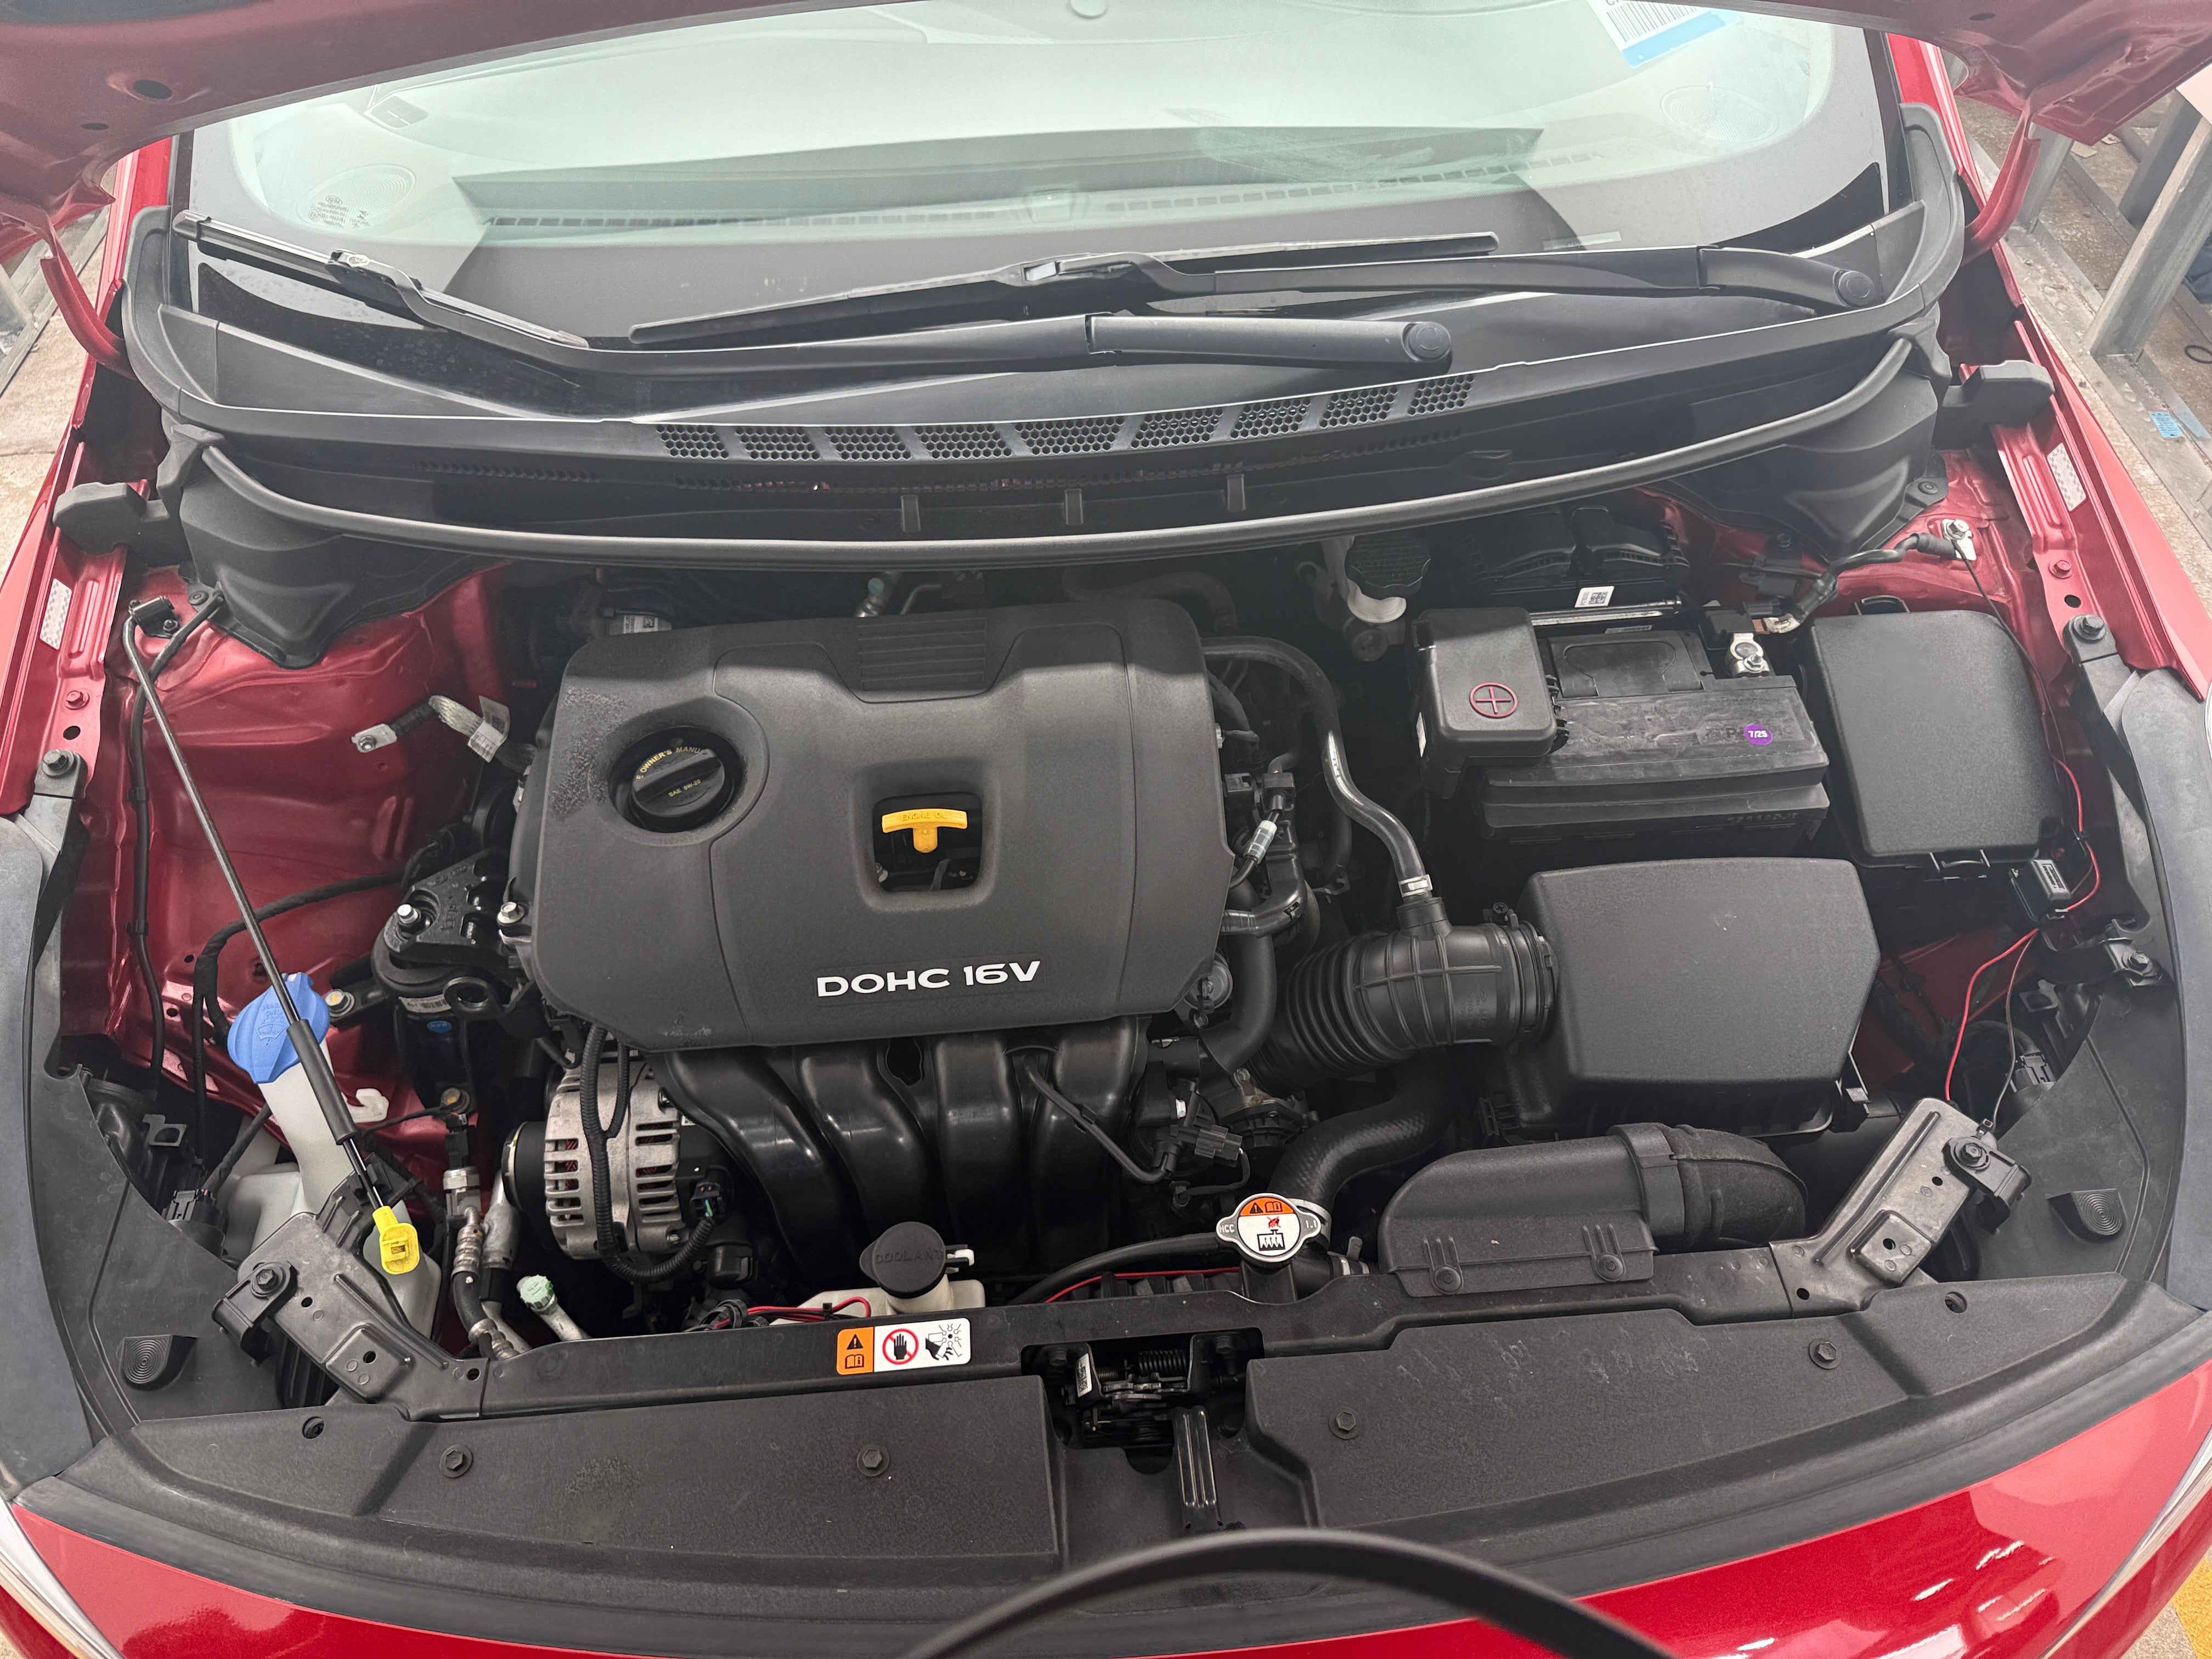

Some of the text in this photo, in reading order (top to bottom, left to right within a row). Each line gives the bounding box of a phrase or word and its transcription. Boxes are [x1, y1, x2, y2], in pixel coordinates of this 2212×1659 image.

[1748, 730, 1768, 738] 7/25
[640, 749, 673, 773] OWNER'S
[668, 779, 702, 797] SAE 5W-20
[901, 811, 930, 821] ENGINE
[817, 961, 1041, 997] DOHC 16V
[1219, 1220, 1317, 1233] HCC 1.1
[876, 1248, 944, 1264] COOLANT
